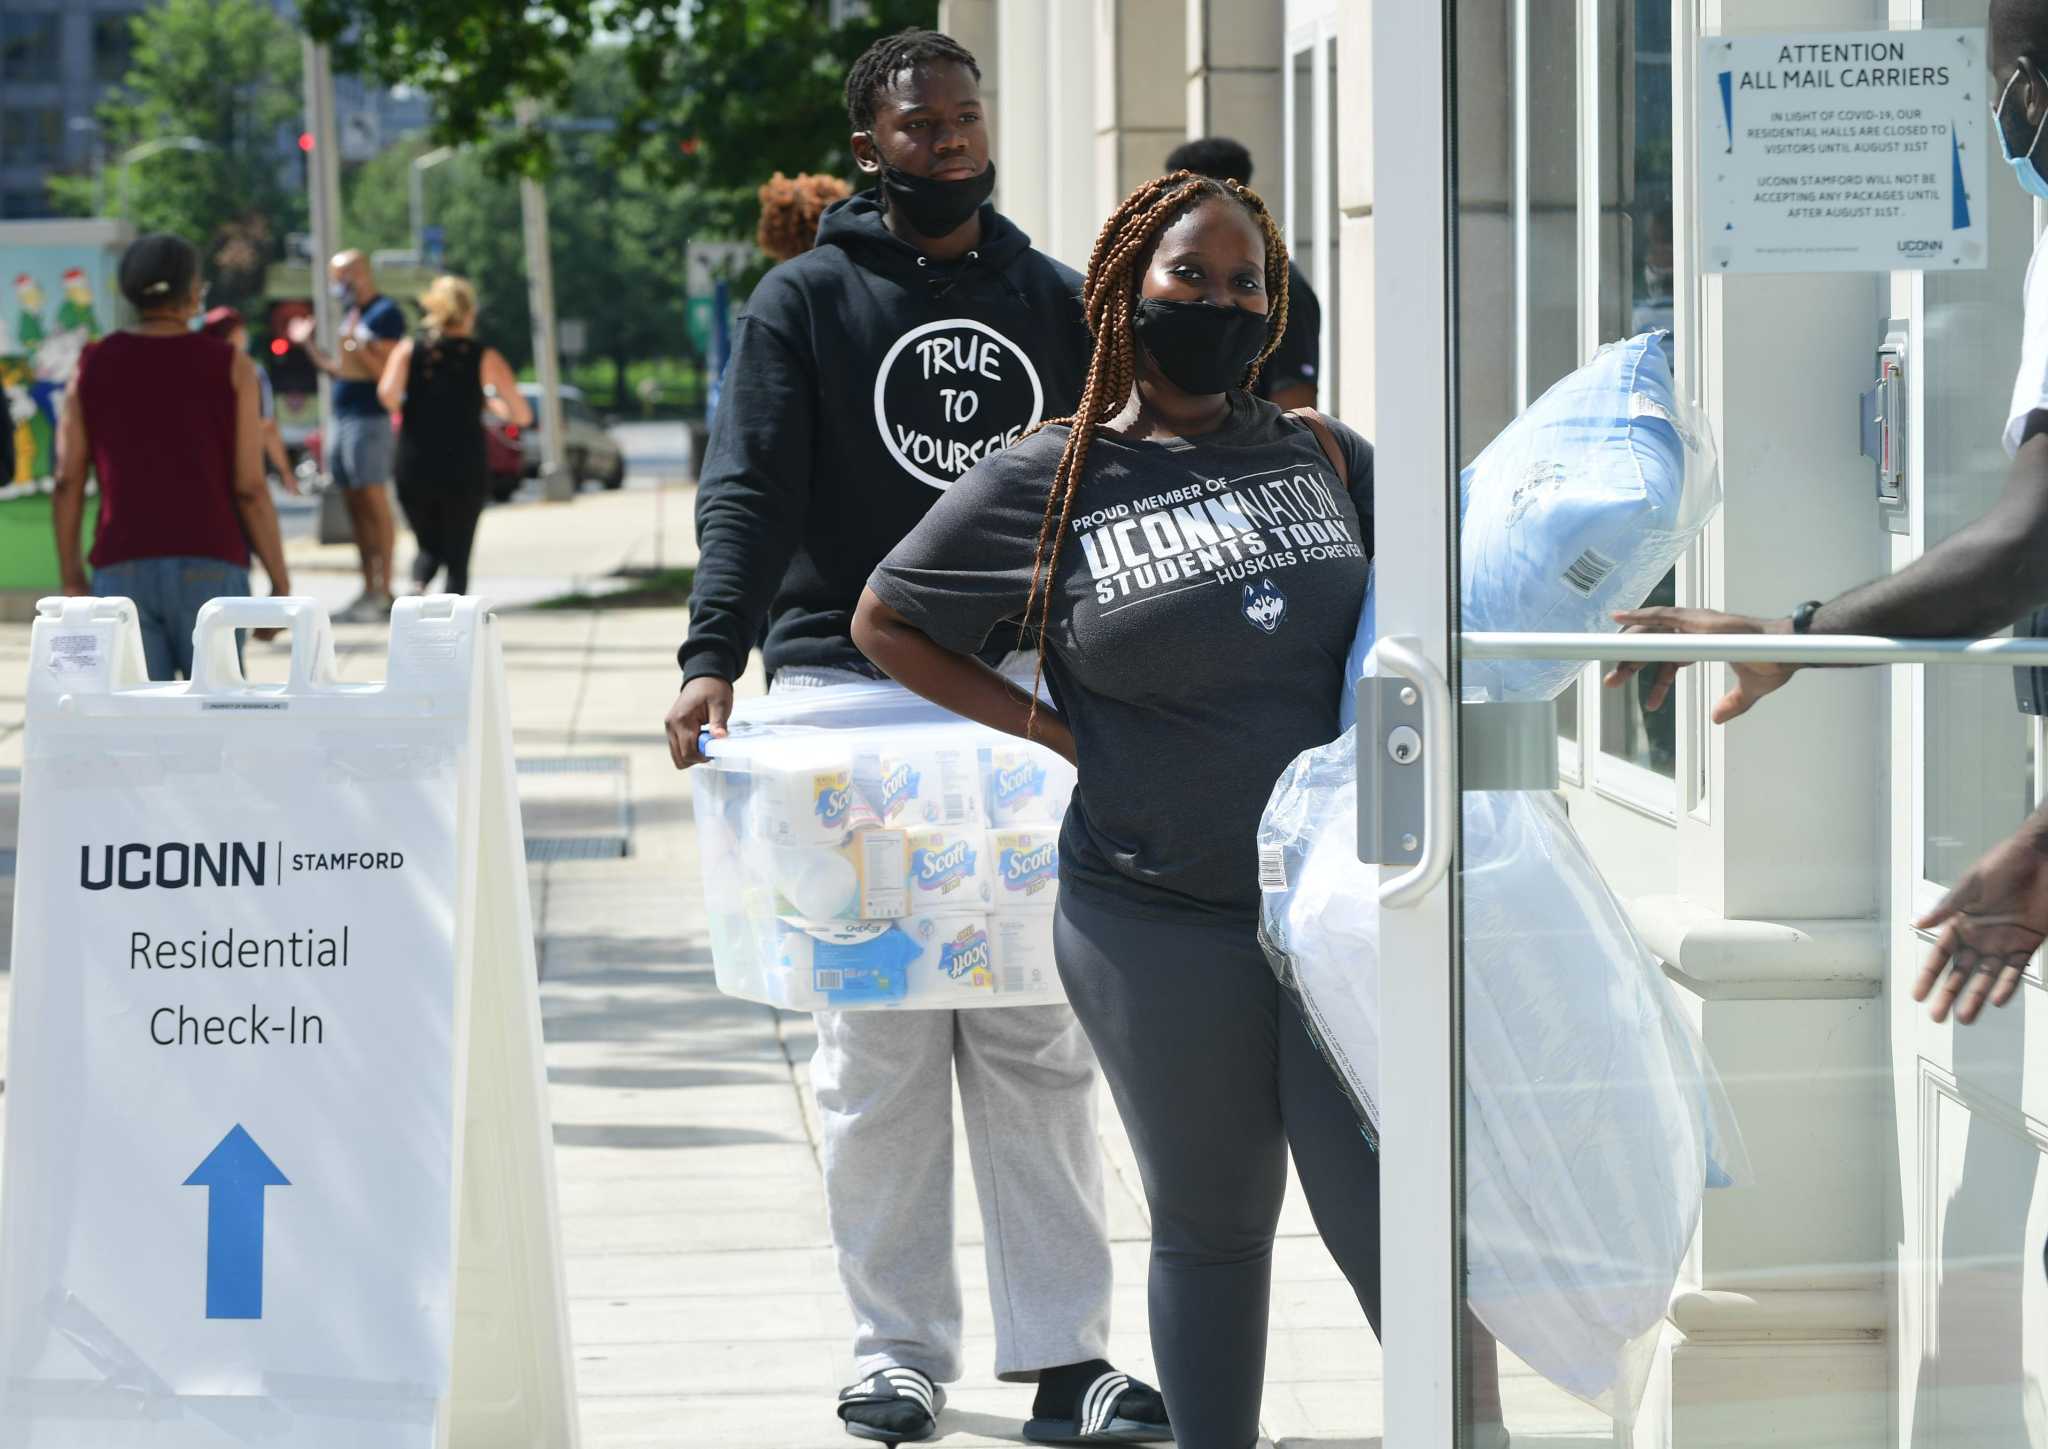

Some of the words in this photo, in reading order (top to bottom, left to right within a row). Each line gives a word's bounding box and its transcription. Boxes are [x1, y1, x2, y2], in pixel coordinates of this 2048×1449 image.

[1778, 43, 1903, 63] ATTENTION
[1740, 72, 1777, 89] ALL
[1784, 70, 1834, 88] MAIL
[1840, 67, 1949, 87] CARRIERS
[1747, 128, 1818, 138] RESIDENTIAL
[1821, 127, 1856, 137] HALLS
[1859, 126, 1880, 136] ARE
[1883, 125, 1928, 136] CLOSED
[1931, 125, 1947, 135] TO
[1771, 112, 1783, 121] IN
[1785, 111, 1818, 122] LIGHT
[1819, 111, 1834, 121] OF
[1898, 109, 1921, 119] OUR
[1765, 144, 1816, 154] VISITORS
[1818, 143, 1851, 153] UNTIL
[1854, 142, 1900, 152] AUGUST
[1904, 141, 1928, 152] 31ST
[1754, 192, 1816, 202] ACCEPTING
[1819, 192, 1842, 200] ANY
[1844, 190, 1904, 201] PACKAGES
[1907, 190, 1940, 200] UNTIL
[1758, 176, 1798, 186] UCONN
[1800, 175, 1863, 186] STAMFORD
[1865, 175, 1892, 185] WILL
[1895, 174, 1919, 184] NOT
[1922, 174, 1936, 184] BE
[1788, 208, 1822, 218] AFTER
[1825, 207, 1872, 218] AUGUST
[1897, 240, 1942, 252] UCONN
[916, 335, 1001, 381] TRUE
[940, 389, 979, 422] TO
[1072, 504, 1129, 532] PROUD
[1135, 485, 1203, 513] MEMBER
[1206, 477, 1228, 492] OF
[1096, 531, 1267, 604] STUDENTS
[1270, 519, 1353, 550] TODAY
[1215, 551, 1297, 585] HUSKIES
[999, 761, 1034, 797] Scott
[81, 842, 265, 890] UCONN
[293, 852, 403, 871] STAMFORD
[922, 842, 967, 878] Scott
[1008, 845, 1055, 878] Scott
[131, 926, 348, 969] Residential
[951, 942, 987, 979] Scott
[151, 1004, 322, 1045] Check-In
